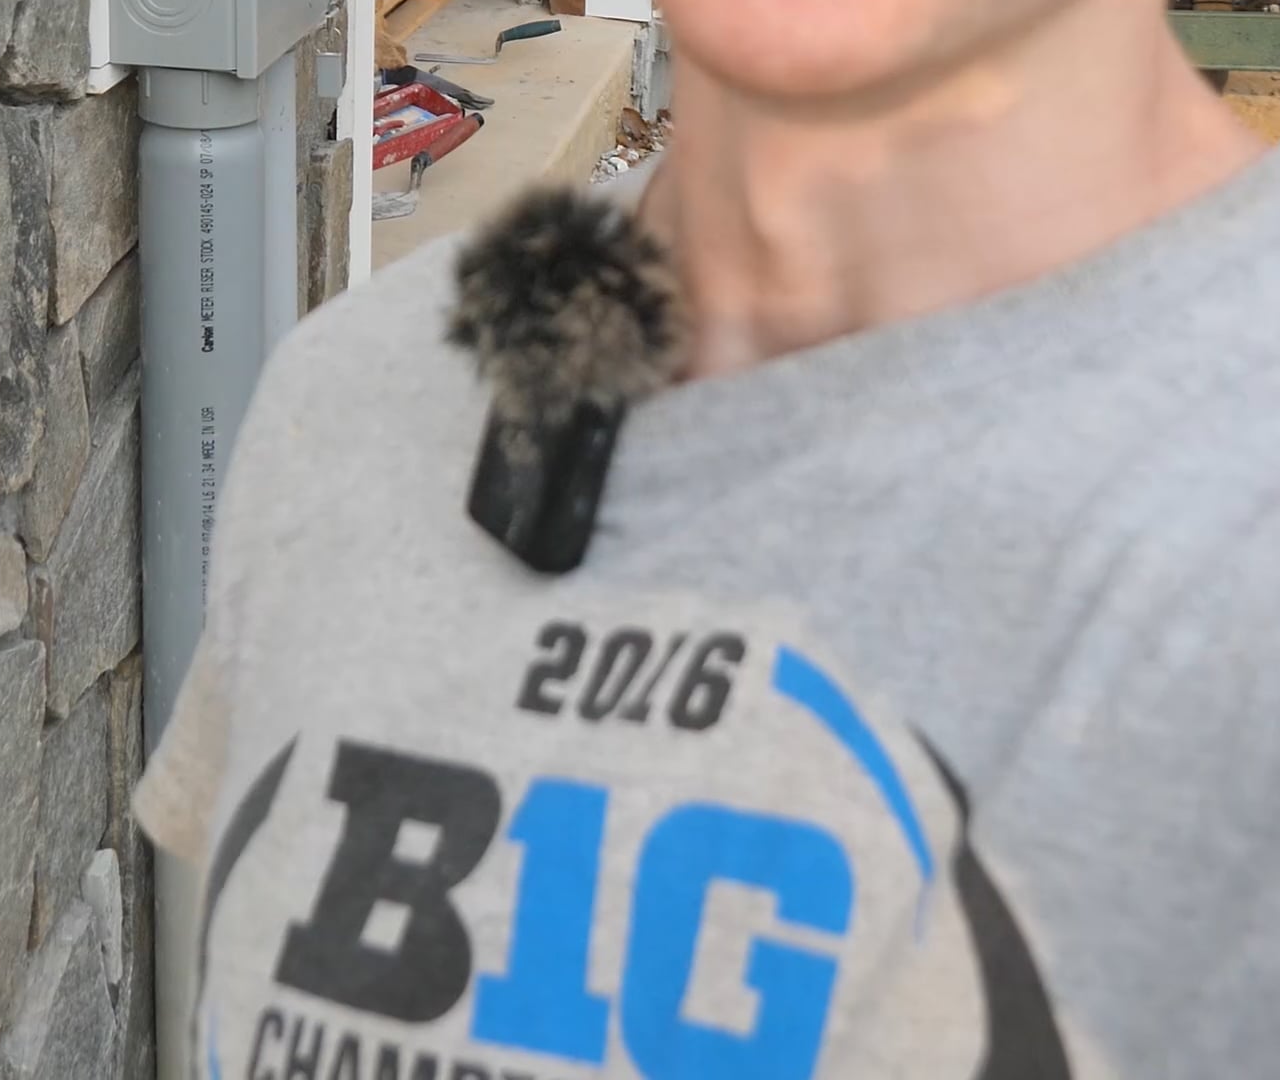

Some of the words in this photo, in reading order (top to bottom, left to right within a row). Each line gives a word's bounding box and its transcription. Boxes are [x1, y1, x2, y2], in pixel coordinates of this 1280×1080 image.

[200, 168, 214, 180] SP
[200, 239, 214, 264] STOCK
[200, 267, 214, 293] RISER
[200, 296, 214, 322] METER
[201, 407, 215, 422] USA
[201, 426, 215, 436] IN
[201, 440, 215, 460] MADE
[515, 620, 746, 732] 2016
